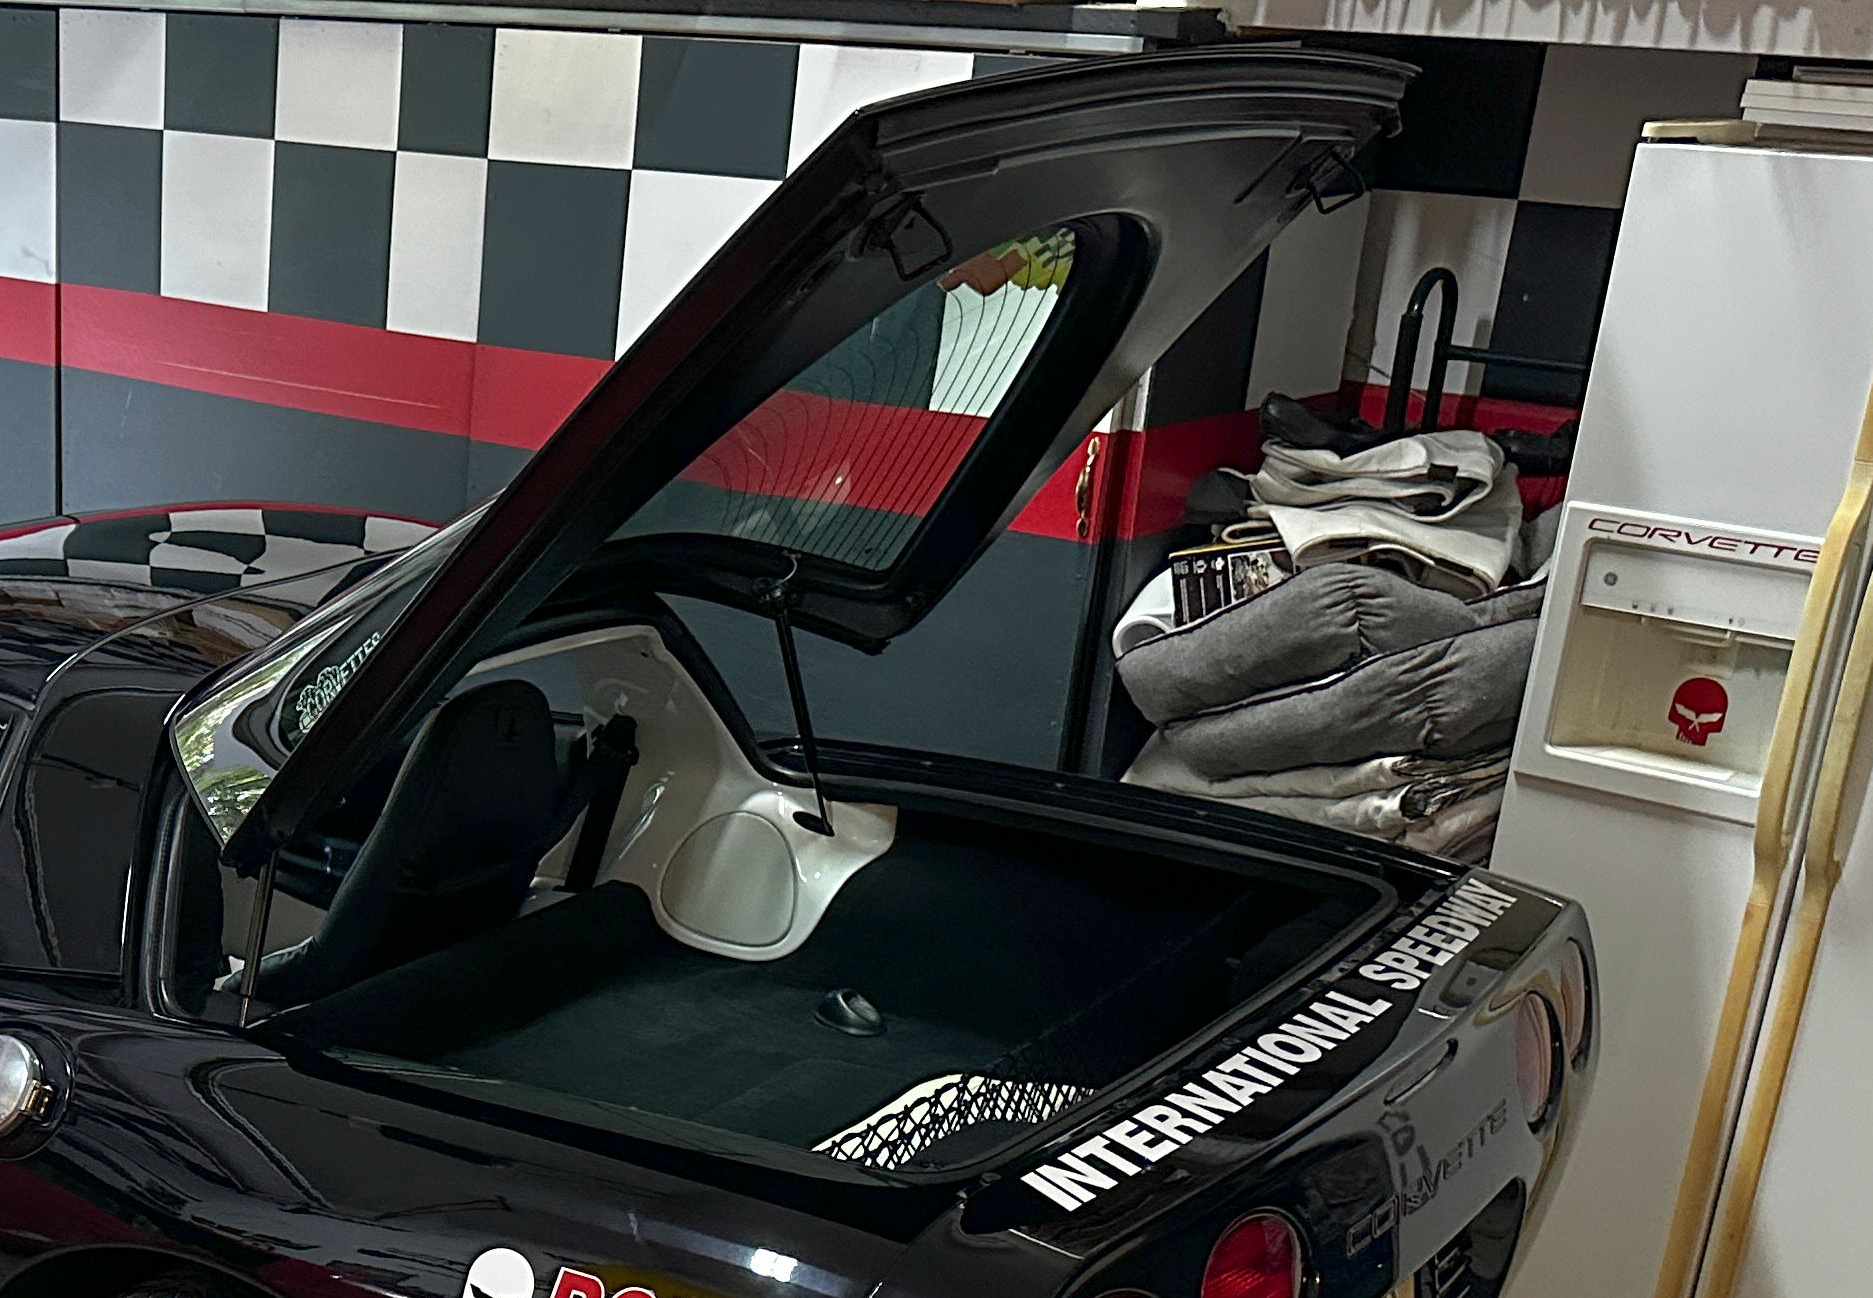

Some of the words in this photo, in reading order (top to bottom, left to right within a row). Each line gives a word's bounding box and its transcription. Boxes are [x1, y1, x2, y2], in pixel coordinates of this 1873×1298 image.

[1588, 518, 1822, 564] CORVETTE
[1358, 877, 1517, 991] SPEEDWAY
[1020, 990, 1393, 1212] INTERNATIONAL
[1346, 1098, 1508, 1260] CORVETTE
